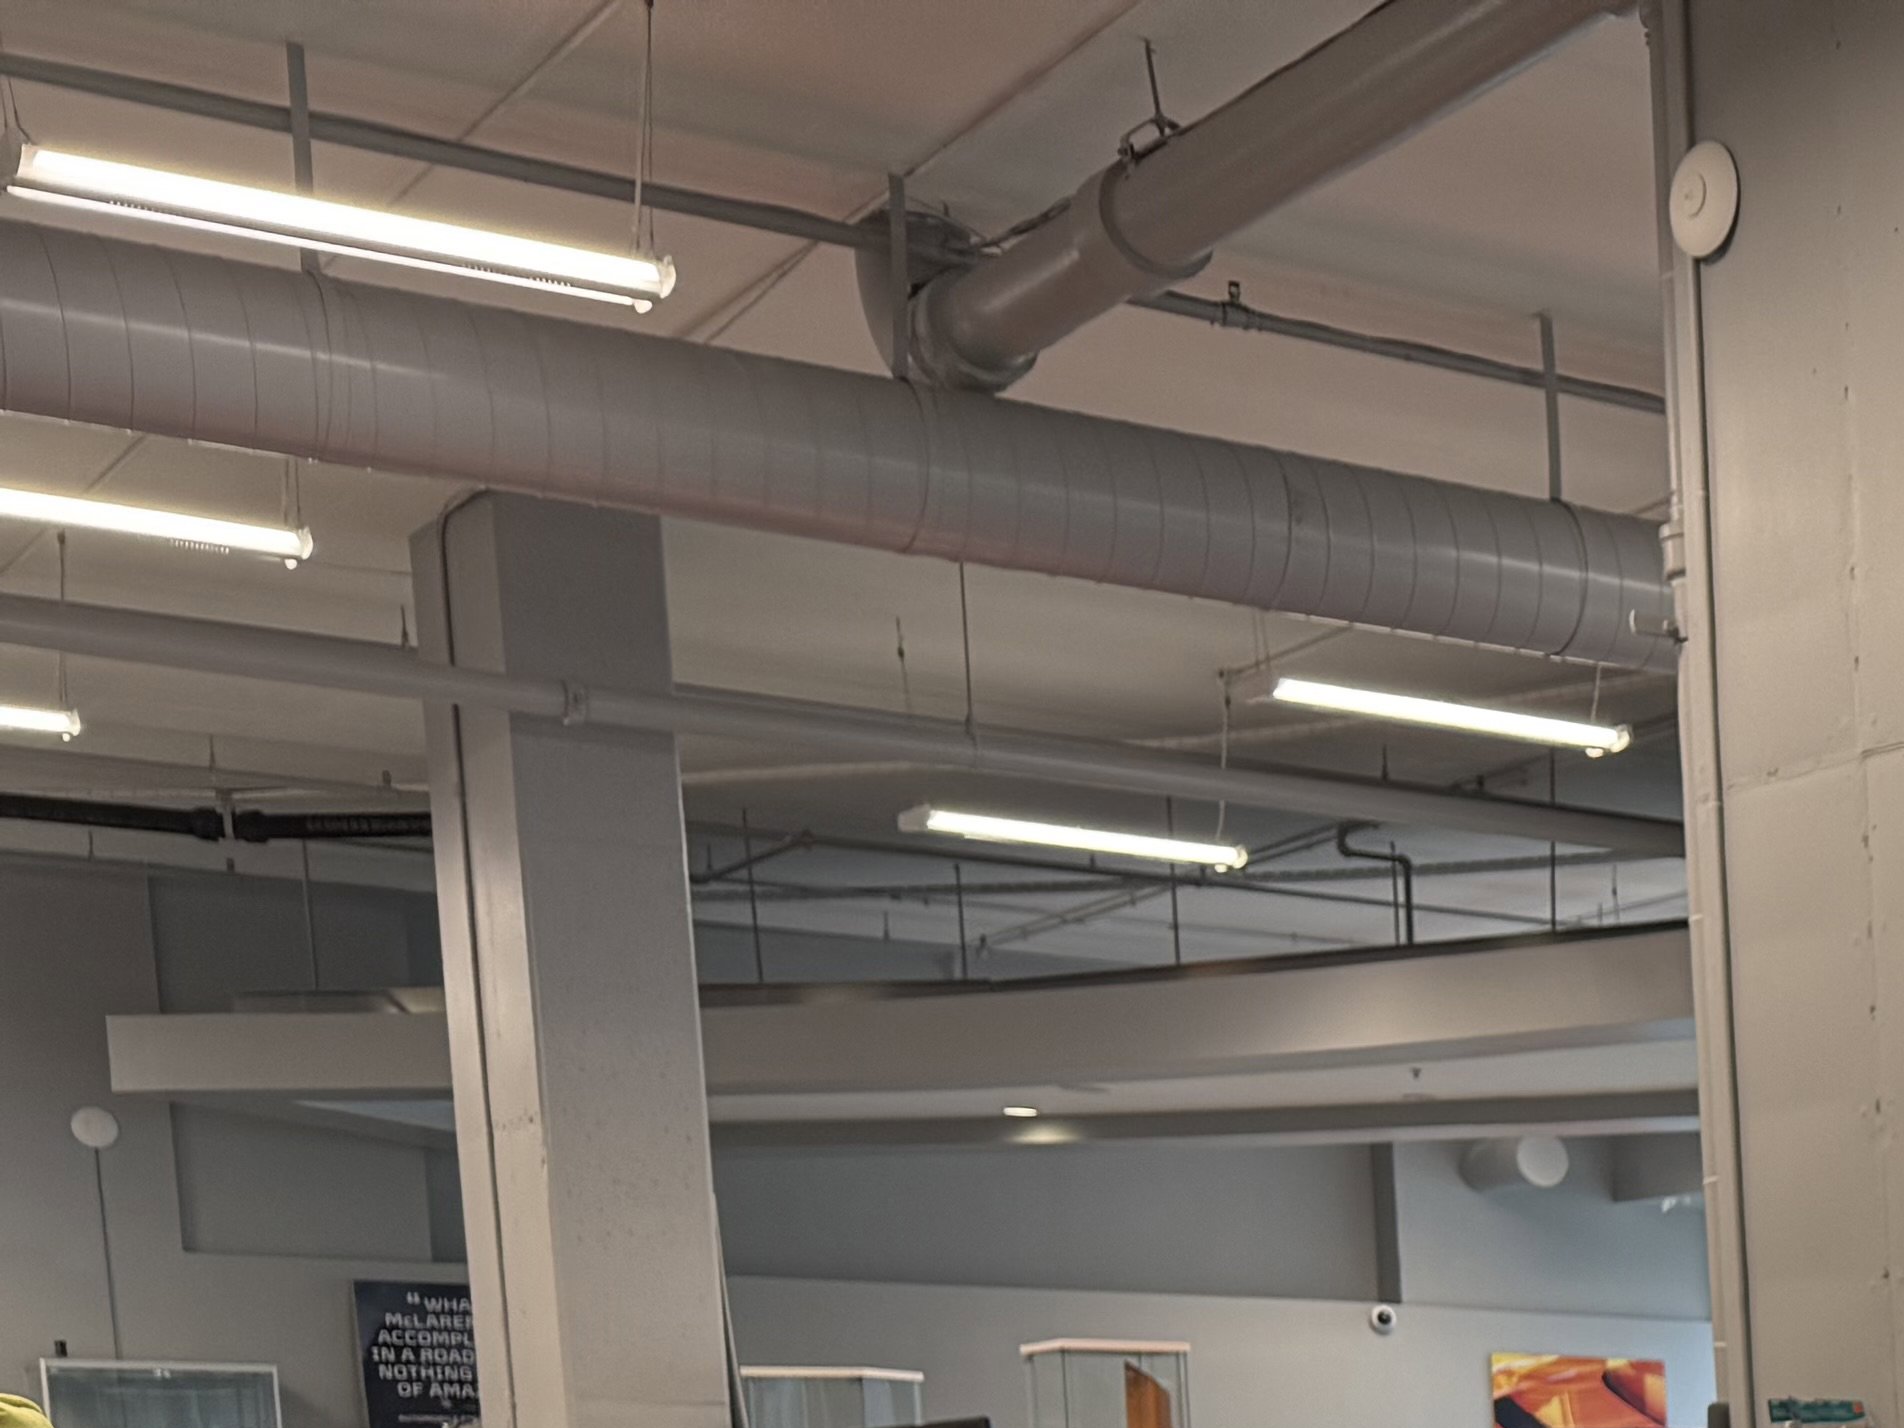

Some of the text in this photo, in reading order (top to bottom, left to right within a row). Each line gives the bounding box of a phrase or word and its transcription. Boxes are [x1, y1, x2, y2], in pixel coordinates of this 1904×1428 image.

[406, 1292, 471, 1312] “WHA
[378, 1329, 474, 1347] ACCOMPL
[371, 1346, 475, 1365] IN A ROAD
[378, 1364, 473, 1382] NOTHING
[397, 1381, 480, 1399] OF AMA
